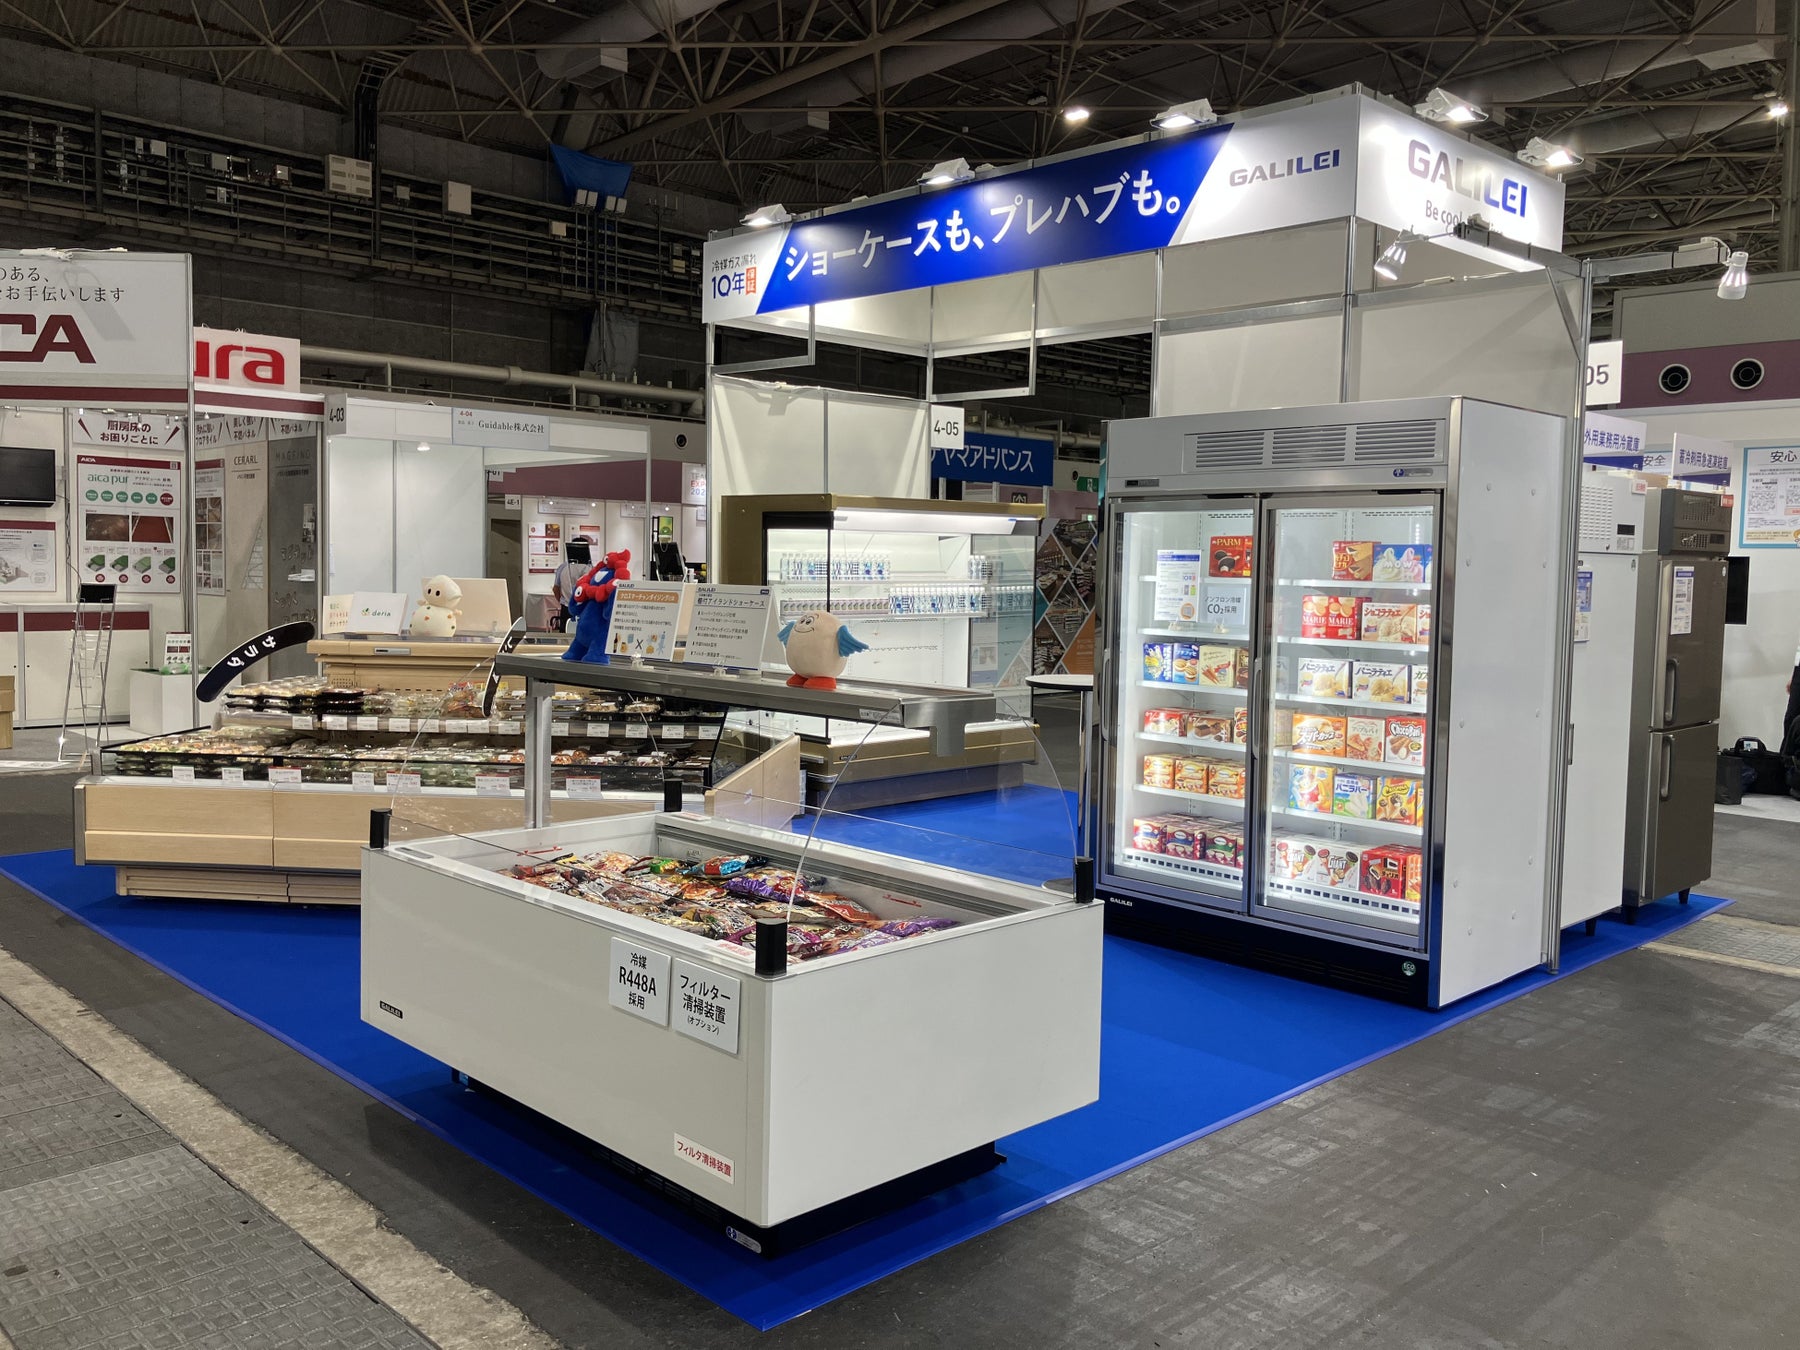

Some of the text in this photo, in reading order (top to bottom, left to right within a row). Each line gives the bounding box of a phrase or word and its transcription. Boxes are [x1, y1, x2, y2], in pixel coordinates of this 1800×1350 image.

[1229, 149, 1340, 187] GALILEI
[1408, 139, 1528, 217] GALILEI
[1426, 200, 1439, 220] Be
[785, 170, 1180, 281] ショーケースも、プレハブも。
[0, 286, 125, 304] お手伝いします
[329, 408, 345, 422] 4-03
[478, 420, 545, 434] Guidable株式会社
[934, 420, 959, 436] 4-05
[100, 432, 159, 445] お困りごとに
[1643, 454, 1666, 467] 安全
[1770, 450, 1798, 463] 安心
[87, 473, 110, 484] aica
[1216, 538, 1241, 546] PARM
[630, 952, 647, 969] 冷媒
[619, 965, 657, 996] R448A
[680, 974, 731, 1000] フィルター
[628, 991, 645, 1009] 採用
[683, 992, 726, 1024] 清掃装置
